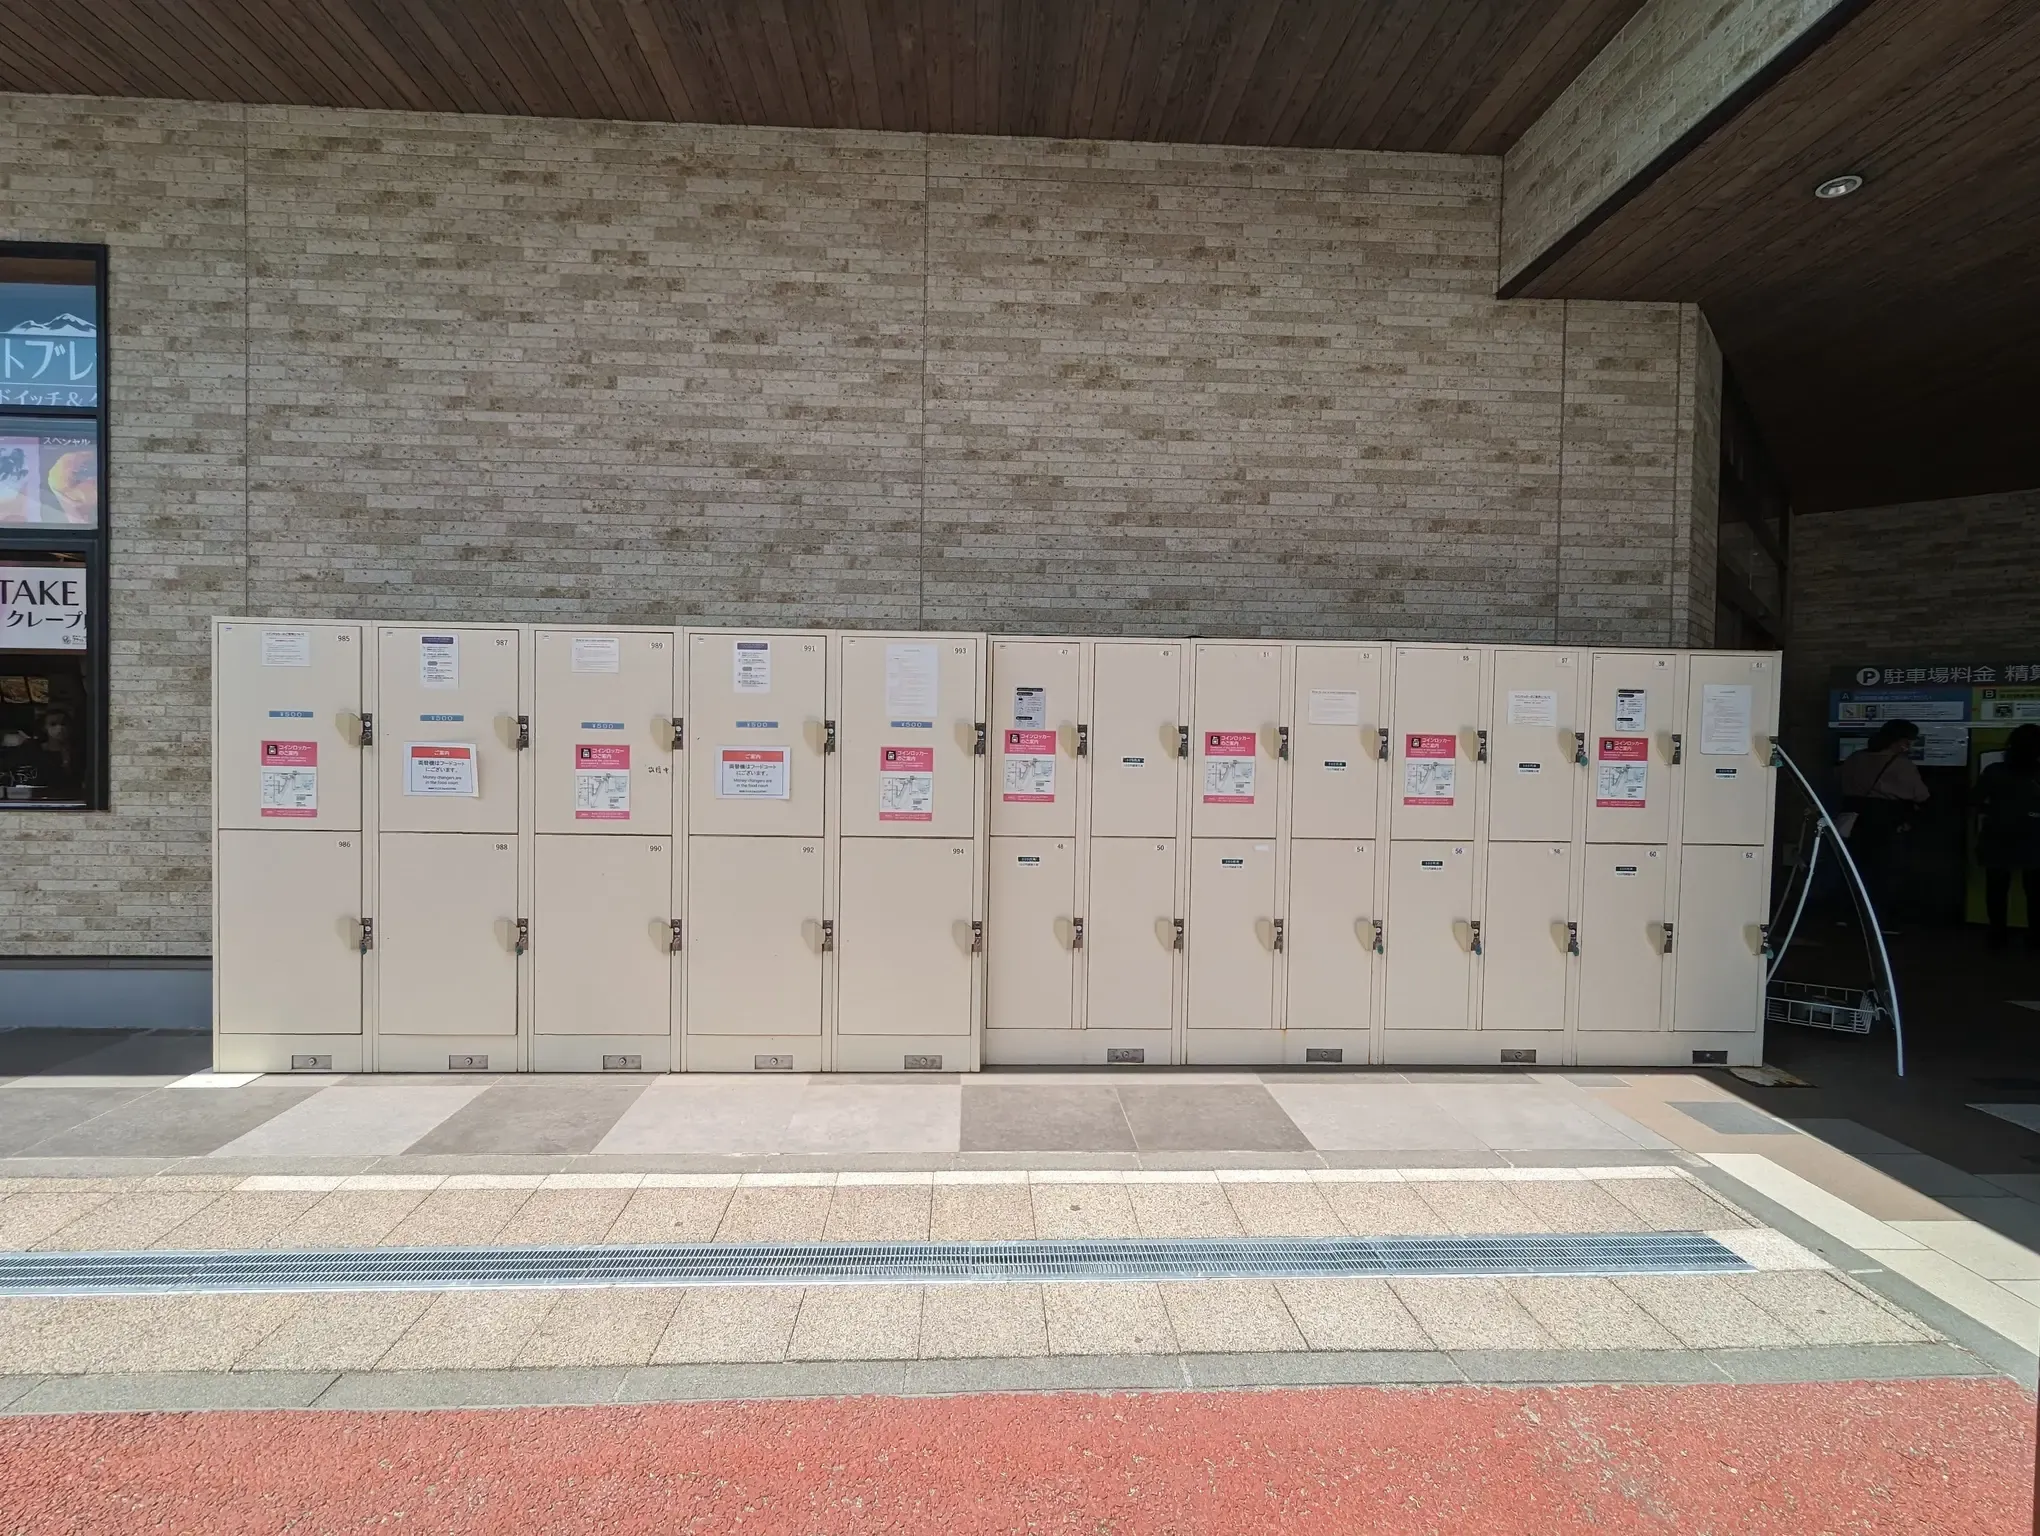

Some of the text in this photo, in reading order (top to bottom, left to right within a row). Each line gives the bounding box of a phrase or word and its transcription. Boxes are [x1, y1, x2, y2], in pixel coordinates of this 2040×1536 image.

[5, 338, 97, 380] トブレ
[0, 579, 79, 605] TAKE
[6, 610, 87, 629] クレープ
[1883, 665, 1997, 684] 駐車場料金
[1985, 690, 1993, 698] B
